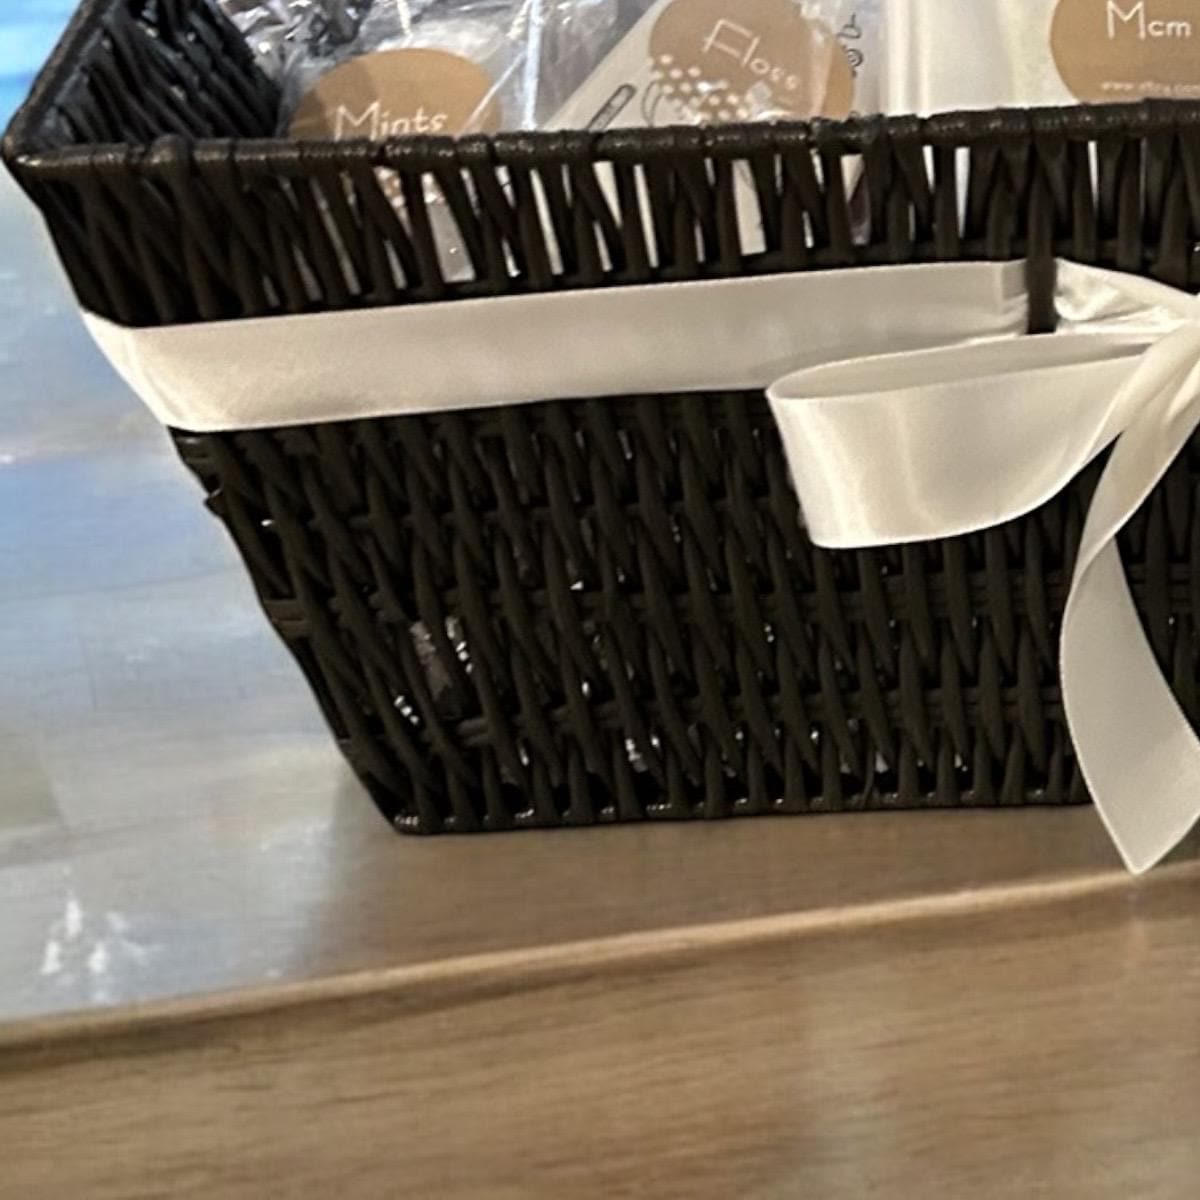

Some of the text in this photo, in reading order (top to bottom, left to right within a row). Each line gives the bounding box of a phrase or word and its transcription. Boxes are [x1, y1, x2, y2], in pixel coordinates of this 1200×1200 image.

[1106, 0, 1192, 41] Mcm
[702, 19, 800, 91] Floss
[334, 100, 448, 142] Mints
